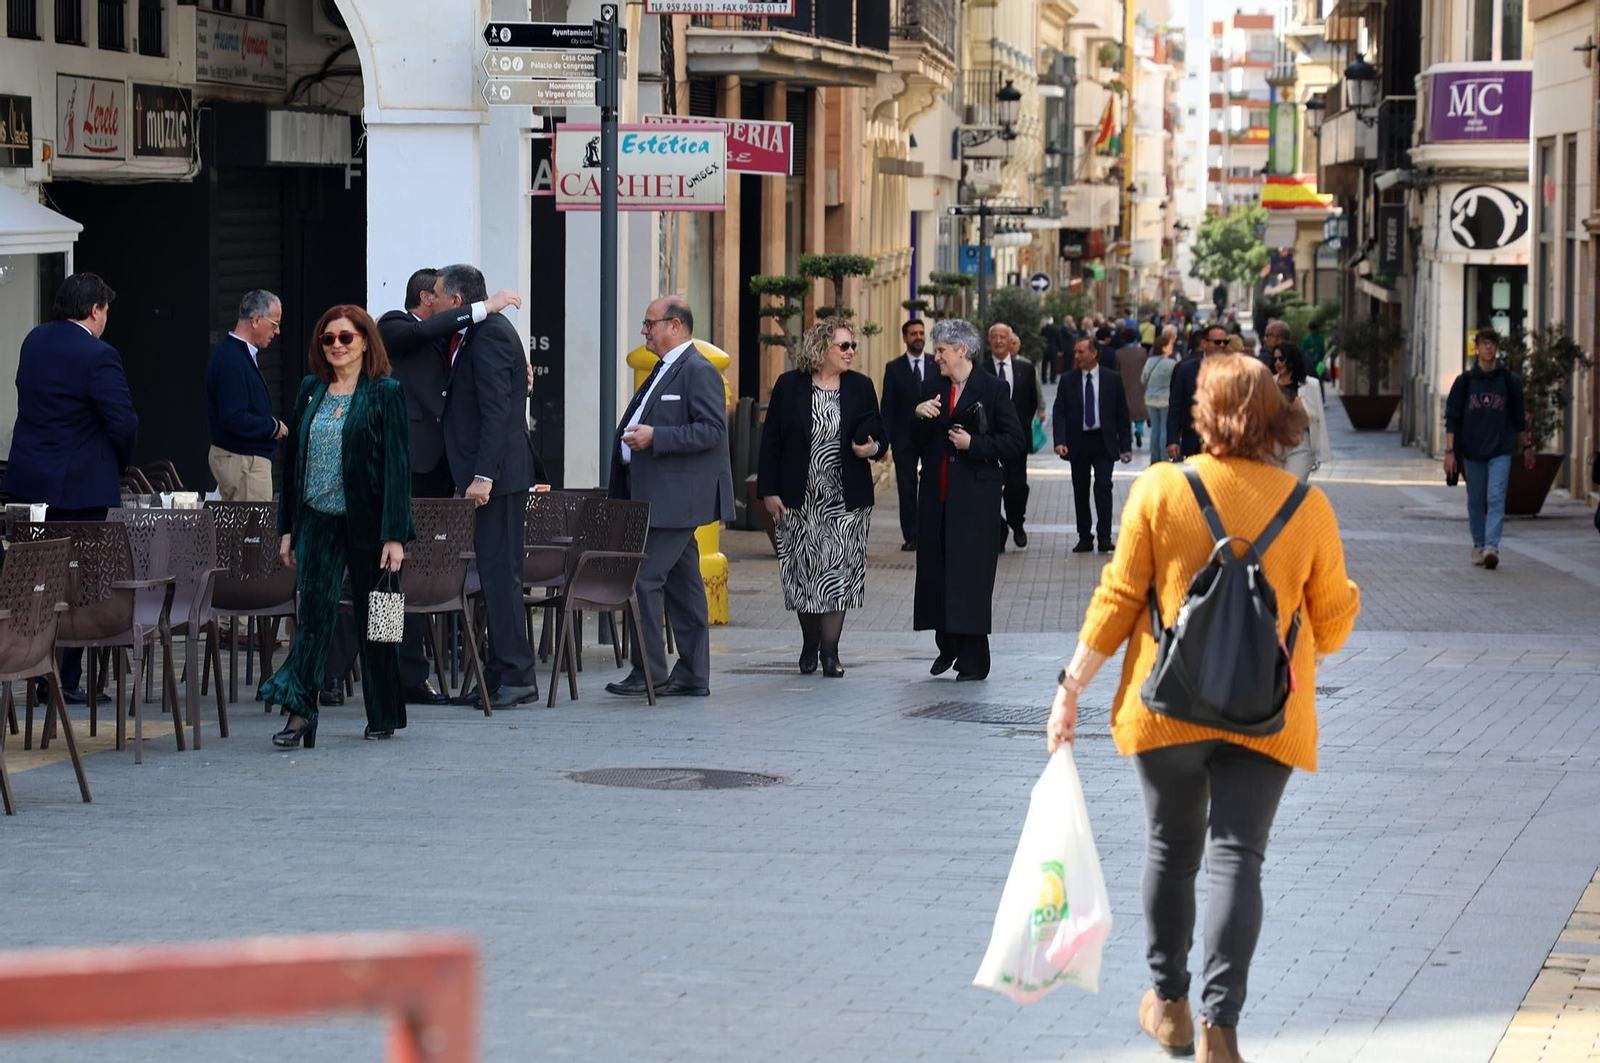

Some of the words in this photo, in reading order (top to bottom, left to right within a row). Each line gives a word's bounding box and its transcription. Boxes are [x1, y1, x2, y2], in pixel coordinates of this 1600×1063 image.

[666, 3, 680, 11] 959
[683, 3, 692, 11] 25
[694, 3, 703, 11] 01
[705, 3, 714, 11] 21
[722, 3, 737, 11] FAX
[740, 4, 753, 12] 959
[756, 4, 765, 12] 25
[767, 4, 776, 12] 01
[779, 4, 788, 12] 17
[530, 61, 553, 69] Palacio
[554, 61, 562, 69] de
[562, 61, 594, 71] Congresos
[549, 82, 584, 90] Monumento
[585, 82, 594, 90] de
[544, 90, 565, 99] Virgen
[1446, 83, 1504, 117] MC
[621, 133, 710, 156] Estética
[685, 161, 720, 189] UNISEX
